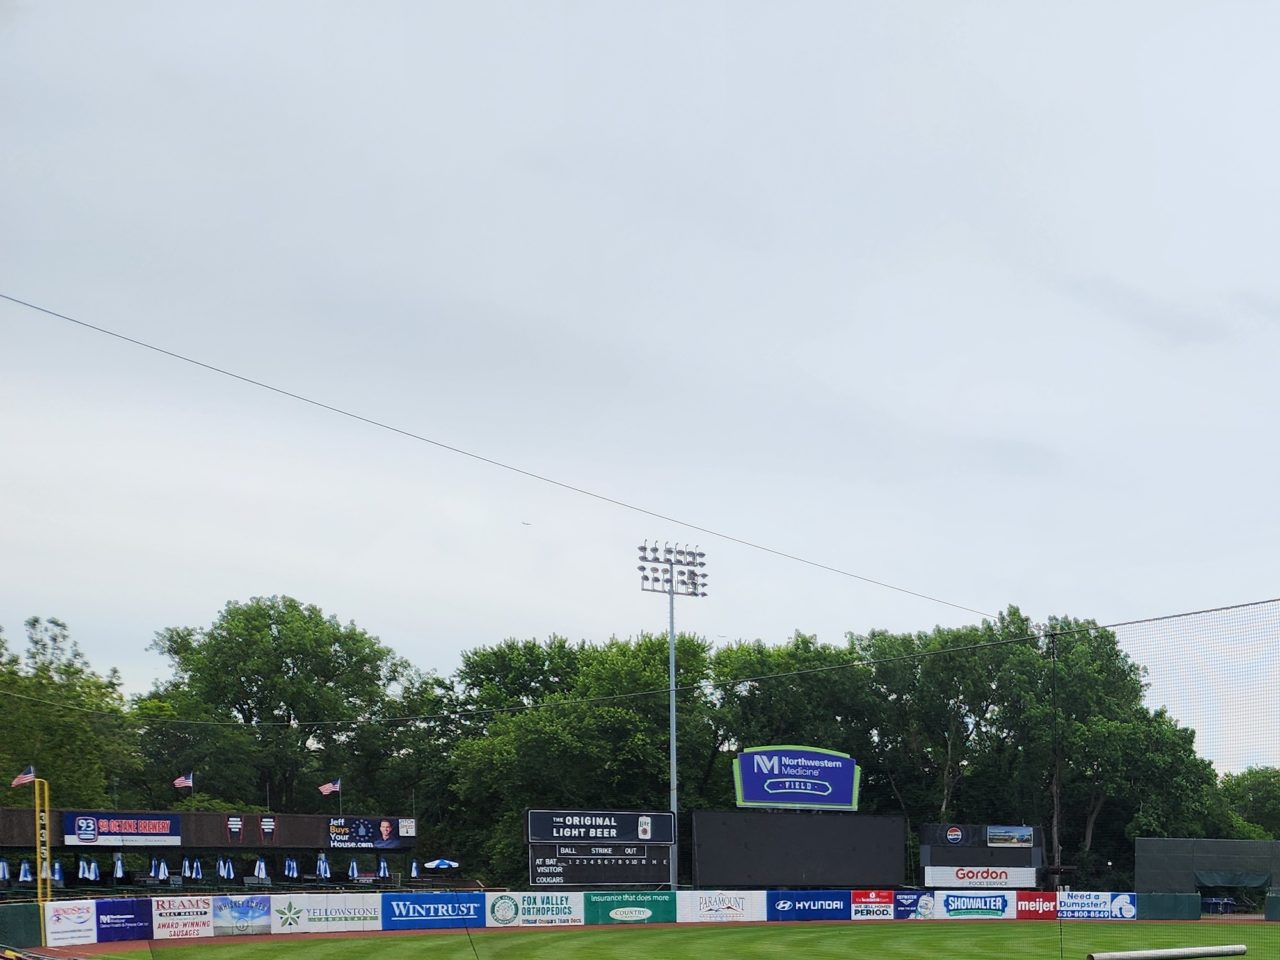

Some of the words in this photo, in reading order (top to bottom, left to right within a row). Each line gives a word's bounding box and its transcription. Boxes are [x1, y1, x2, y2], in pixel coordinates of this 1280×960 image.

[781, 756, 842, 768] Northwestern
[781, 766, 820, 777] Medicine
[785, 782, 812, 790] FIELD
[78, 819, 95, 831] 93
[329, 818, 345, 827] Jeff
[565, 816, 618, 826] ORIGINAL
[110, 820, 137, 833] OCTANE
[138, 820, 171, 834] BREWERY
[329, 826, 350, 835] Buys
[330, 833, 350, 841] Your
[552, 828, 586, 837] LIGHT
[589, 828, 618, 837] BEER
[330, 840, 374, 848] House.com
[955, 868, 1008, 880] Gordon
[521, 895, 537, 905] FOX
[540, 895, 570, 905] VALLEY
[591, 894, 622, 902] Insurance
[1067, 892, 1091, 900] Need
[156, 897, 211, 911] REAM'S
[216, 900, 245, 912] WHISKEY
[699, 896, 745, 911] PARAMOUNT
[795, 900, 844, 910] HYUNDAI
[948, 896, 1003, 910] SHOWALTER
[1017, 898, 1056, 913] meijer
[1060, 900, 1107, 909] Dumpster?
[305, 907, 379, 917] YELLOWSTONE
[391, 901, 478, 917] WINTRUST
[521, 906, 573, 916] ORTHOPEDICS
[854, 908, 892, 916] PERIOD.
[157, 920, 211, 929] AWARD-WINNING
[168, 929, 200, 937] SAUSAGES
